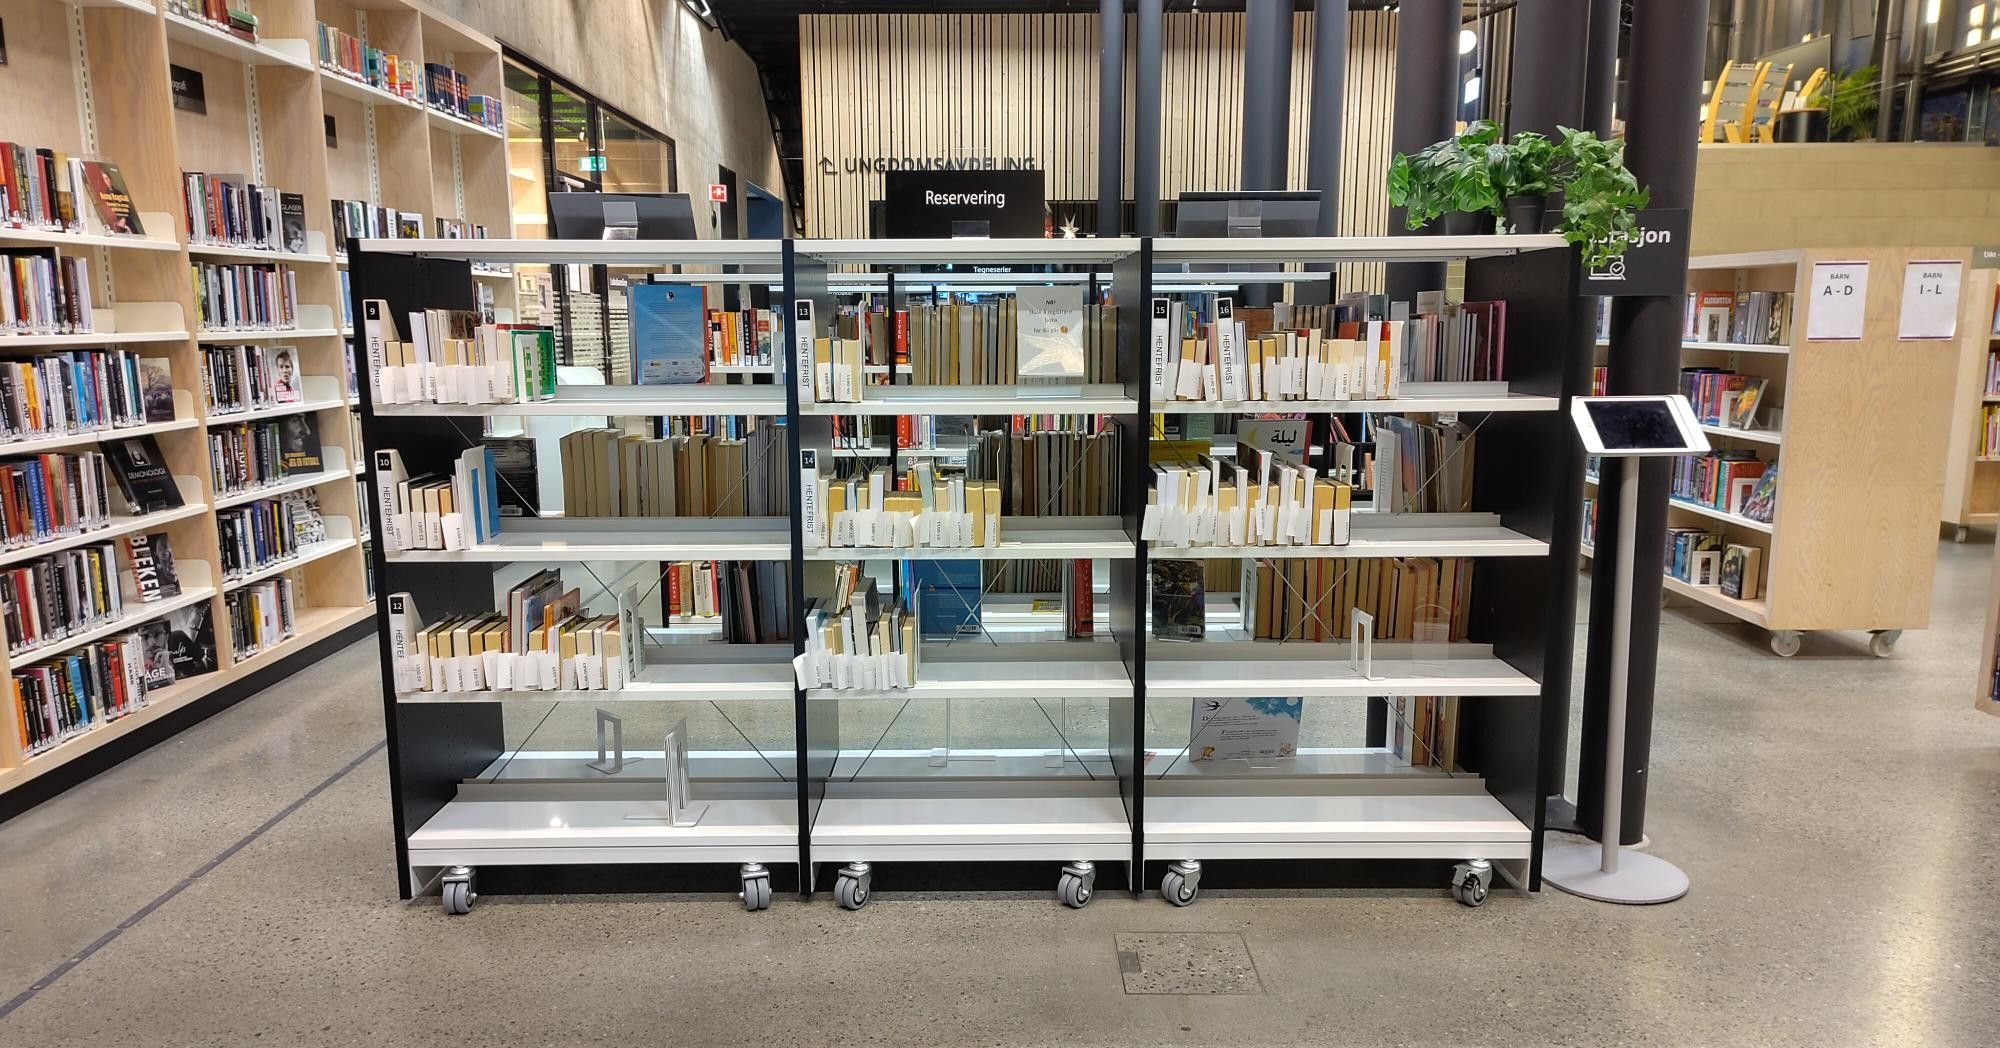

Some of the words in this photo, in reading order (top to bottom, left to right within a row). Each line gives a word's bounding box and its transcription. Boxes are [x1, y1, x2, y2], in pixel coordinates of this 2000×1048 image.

[845, 156, 1036, 173] UNGDOMSAVDELING
[925, 189, 1006, 209] Reservering
[973, 266, 1012, 274] Tegneserier
[1823, 284, 1833, 296] A
[1844, 284, 1853, 296] D
[1935, 284, 1942, 295] L
[369, 307, 376, 316] 9
[798, 308, 808, 316] 13
[1156, 306, 1166, 314] 15
[1220, 306, 1230, 314] 16
[800, 336, 810, 389] HENTEFRIST
[1154, 335, 1164, 386] HENTEFRIST
[1223, 334, 1233, 385] HENTEFRIST
[1270, 429, 1298, 447] ليلة
[379, 458, 390, 466] 10
[804, 456, 814, 464] 14
[805, 484, 815, 534] HENTEFRIST
[130, 535, 162, 602] BLEKEN
[392, 602, 403, 610] 12
